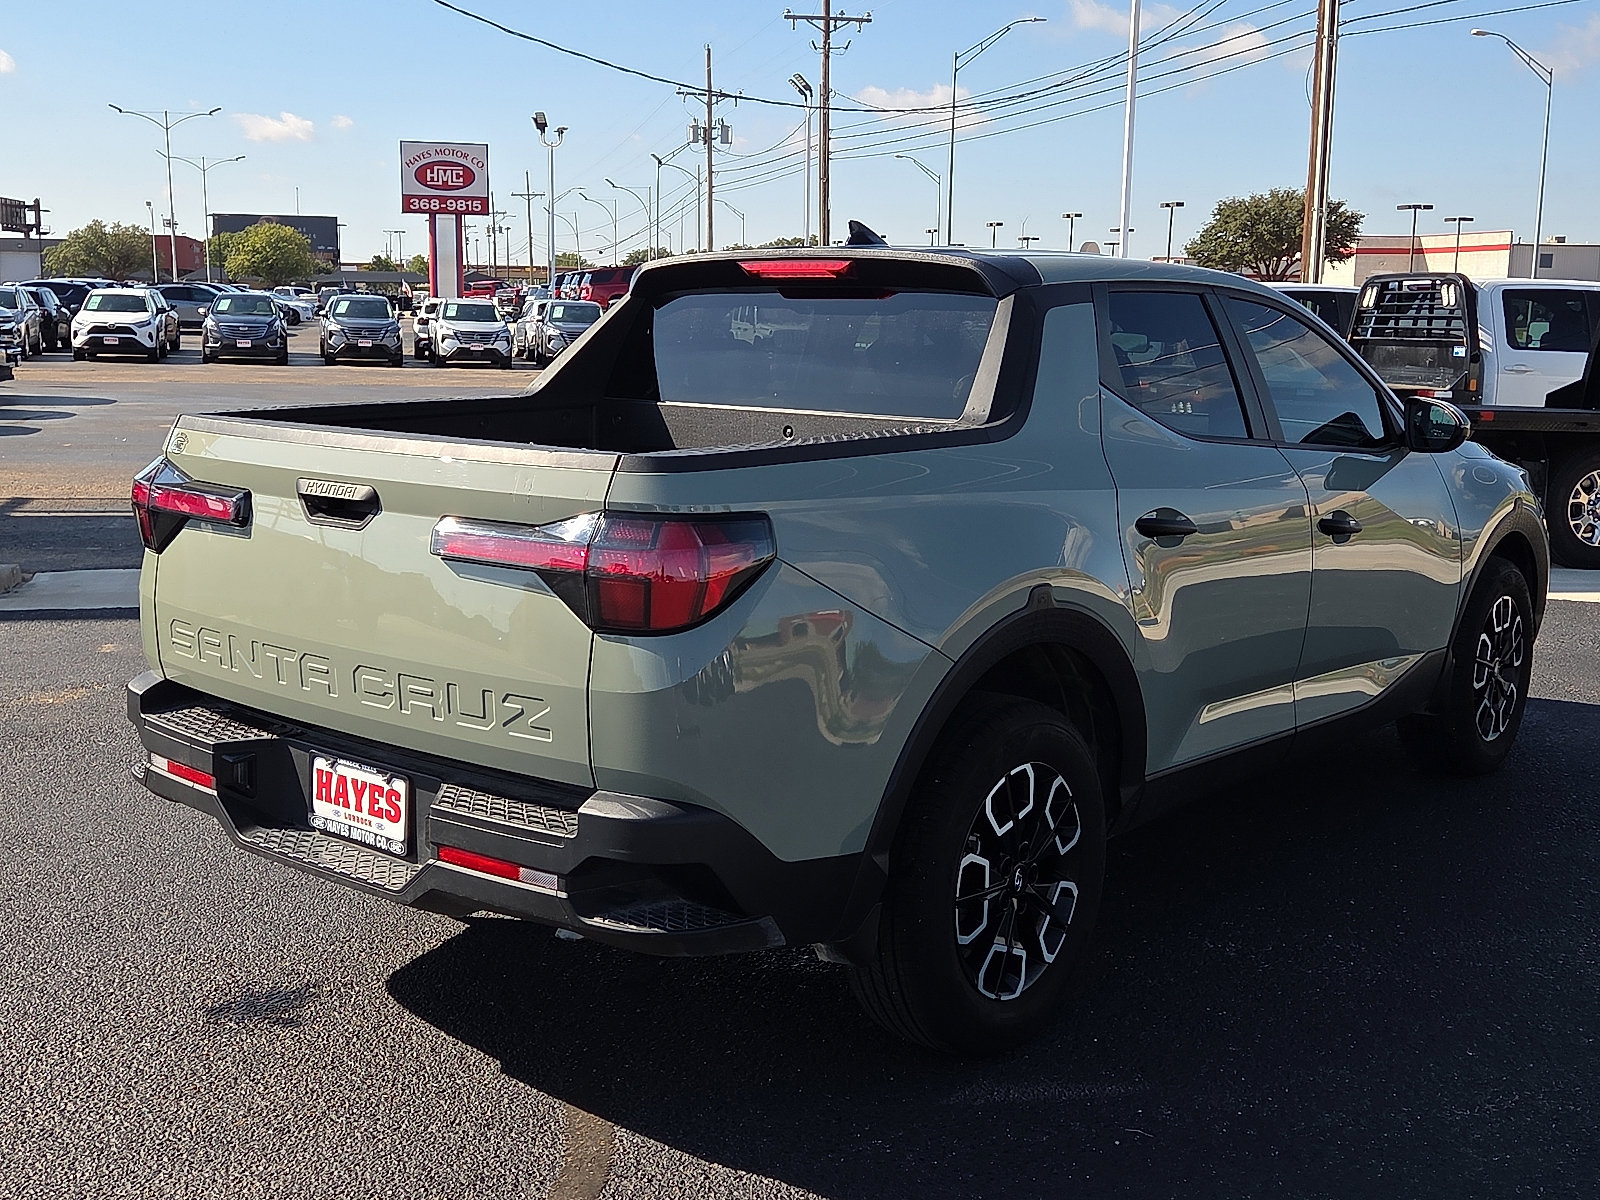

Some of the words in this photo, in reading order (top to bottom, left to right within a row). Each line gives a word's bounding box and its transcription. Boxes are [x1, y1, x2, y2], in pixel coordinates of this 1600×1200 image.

[405, 150, 432, 168] HAYES
[434, 148, 469, 161] MOTOR
[471, 156, 485, 171] CO.
[426, 165, 464, 186] HMC
[409, 198, 482, 212] 368-9815
[305, 481, 358, 499] HYUNDAI
[169, 617, 339, 698] SANTA
[352, 664, 553, 743] CRUZ
[315, 767, 402, 824] HAYES
[343, 812, 373, 828] LUBBOCK
[327, 819, 350, 837] HAYES
[350, 826, 376, 846] MOTOR
[376, 834, 388, 850] CO.
